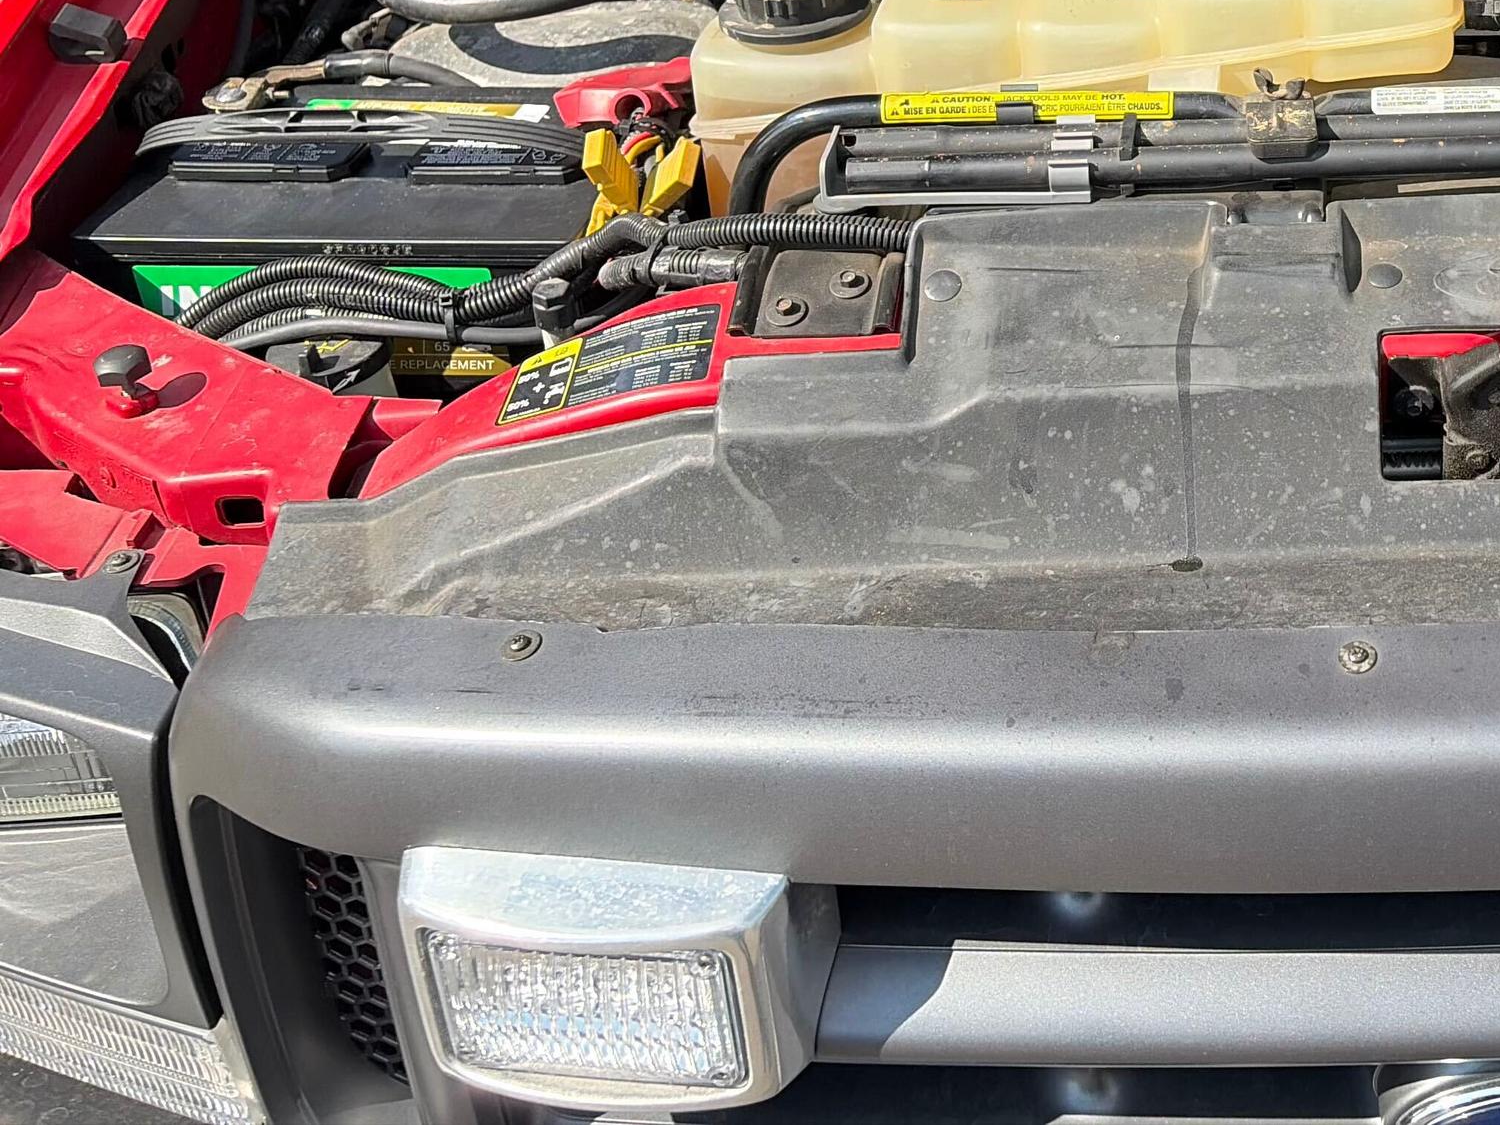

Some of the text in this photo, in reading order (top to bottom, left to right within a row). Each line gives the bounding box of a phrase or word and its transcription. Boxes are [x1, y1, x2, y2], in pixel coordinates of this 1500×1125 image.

[1101, 93, 1126, 101] HOT.
[903, 106, 924, 116] MISE
[926, 106, 937, 115] EN
[972, 105, 987, 114] DES
[1060, 103, 1106, 112] POURRAIENT
[1128, 101, 1163, 111] CHAUDS.
[434, 341, 451, 352] 65
[400, 359, 495, 370] REPLACEMENT
